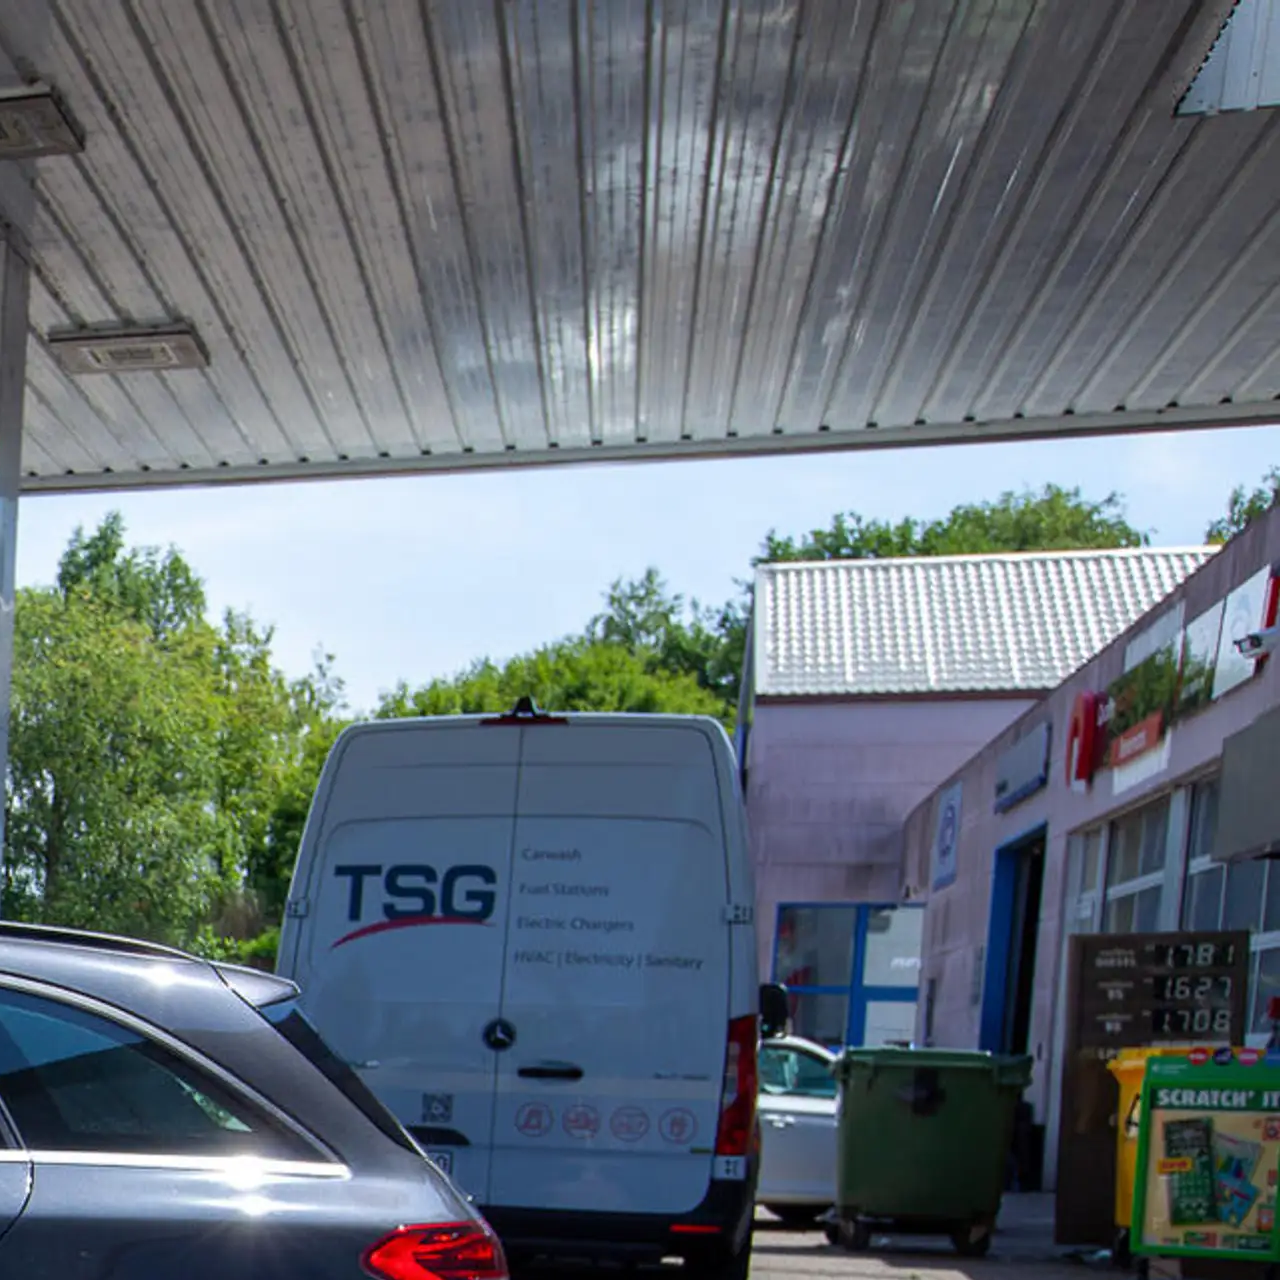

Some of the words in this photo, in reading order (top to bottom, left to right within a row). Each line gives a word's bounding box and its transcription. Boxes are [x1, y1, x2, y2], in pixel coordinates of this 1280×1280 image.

[521, 848, 582, 861] Carwash
[334, 865, 497, 922] TSG
[520, 883, 550, 896] Fuel
[553, 883, 610, 897] Stations
[517, 916, 566, 930] Electric
[570, 917, 635, 934] Chargers
[514, 949, 552, 964] HVAC
[565, 950, 635, 968] Electricity
[645, 953, 704, 970] Sanitary
[1157, 1088, 1254, 1108] SCRATCH'
